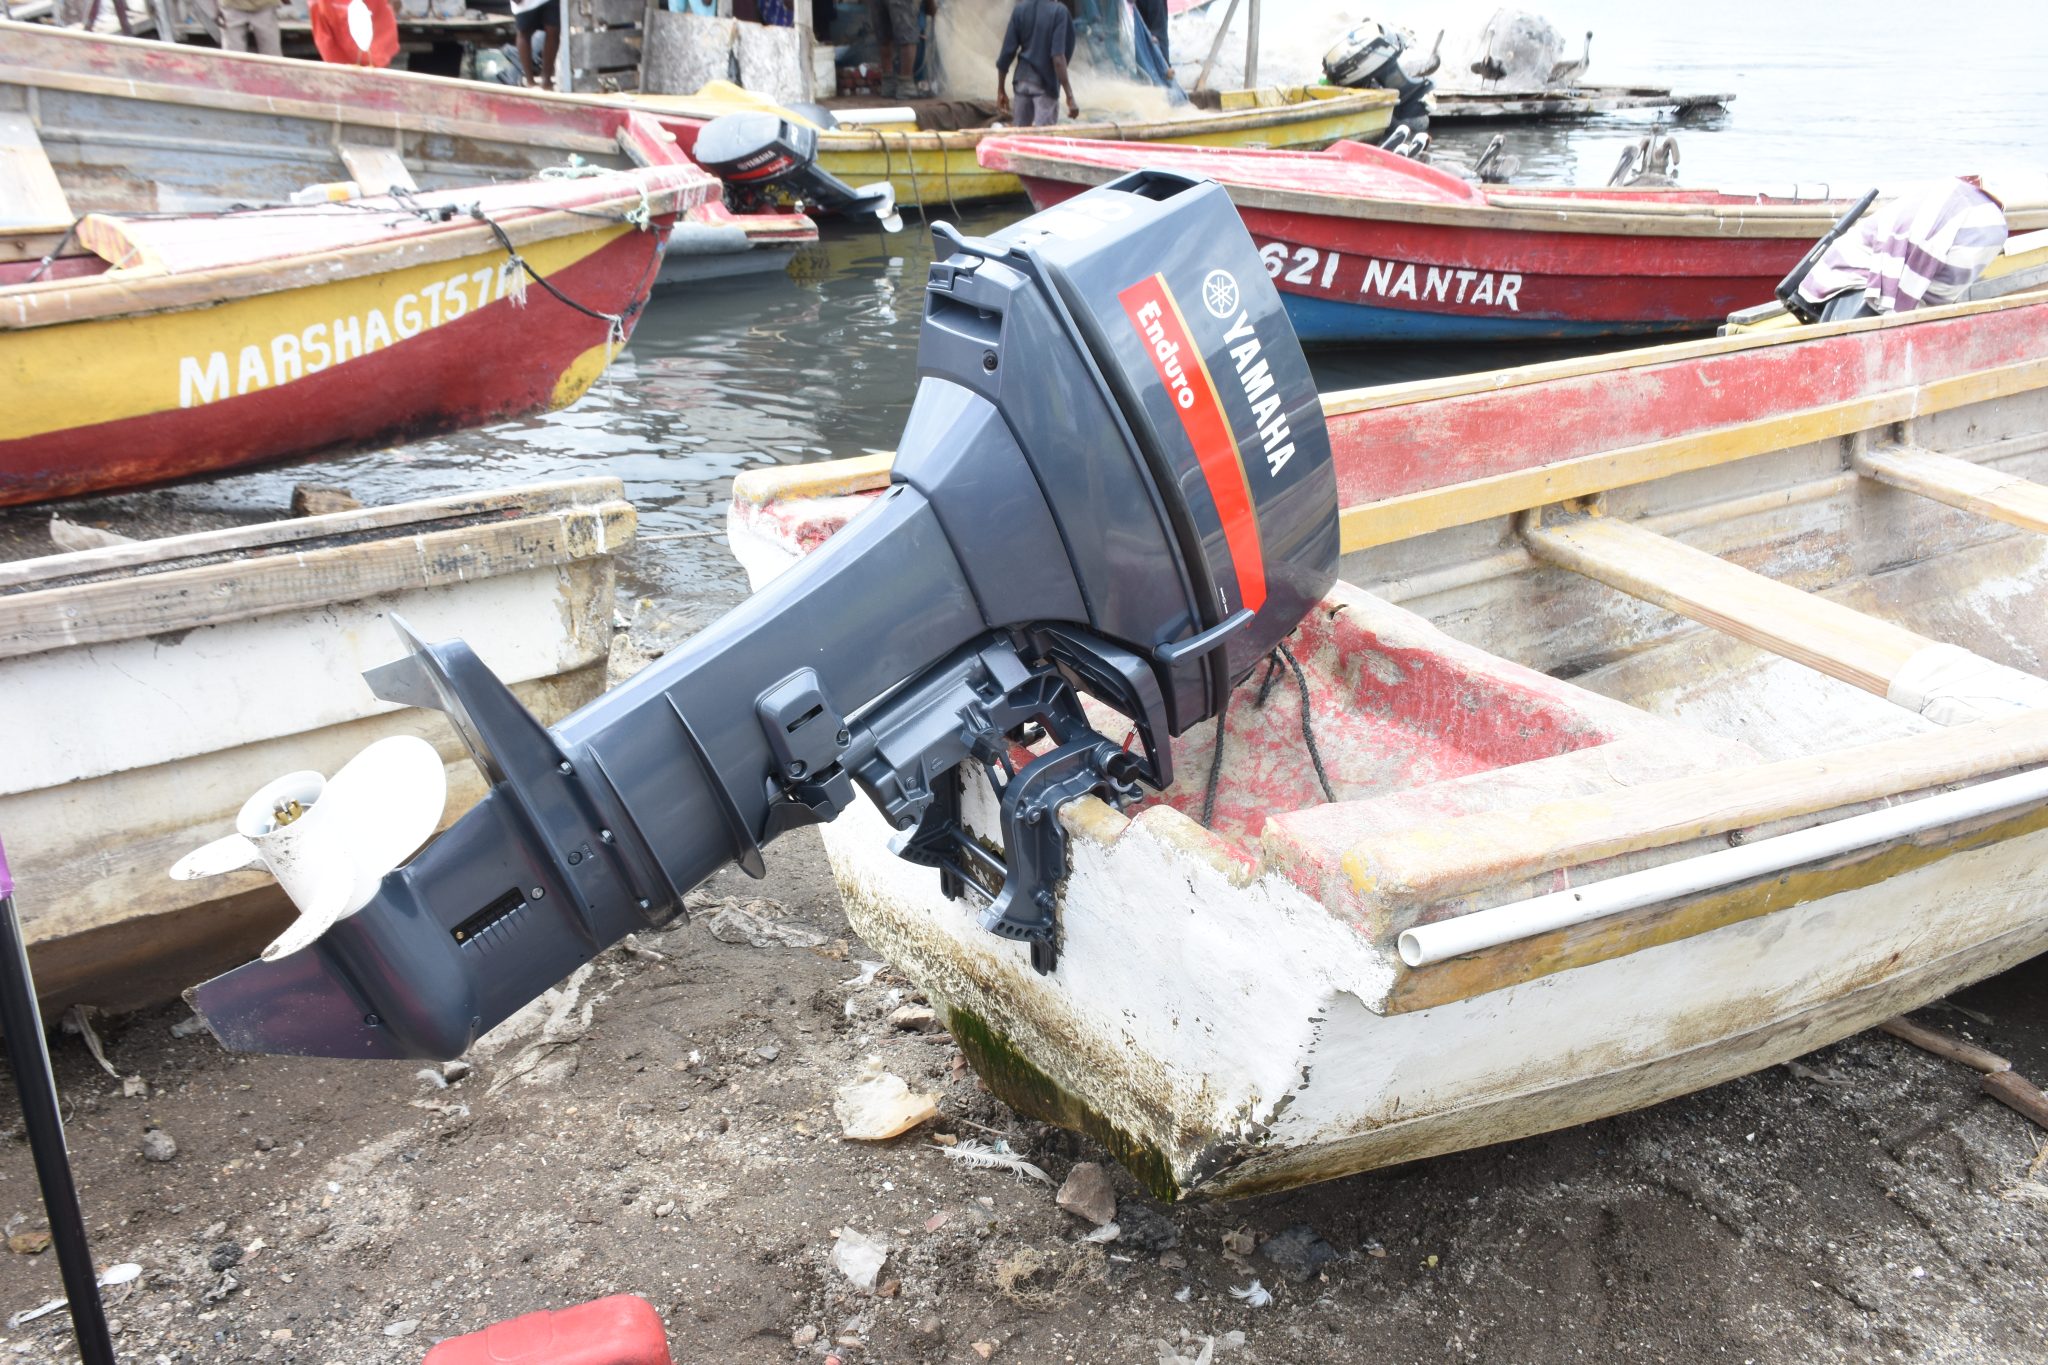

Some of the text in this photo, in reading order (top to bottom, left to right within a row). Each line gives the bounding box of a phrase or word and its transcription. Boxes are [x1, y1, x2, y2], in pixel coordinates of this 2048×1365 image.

[1360, 259, 1523, 311] NANTAR
[1136, 299, 1195, 409] Enduro
[1222, 309, 1296, 478] YAMAHA
